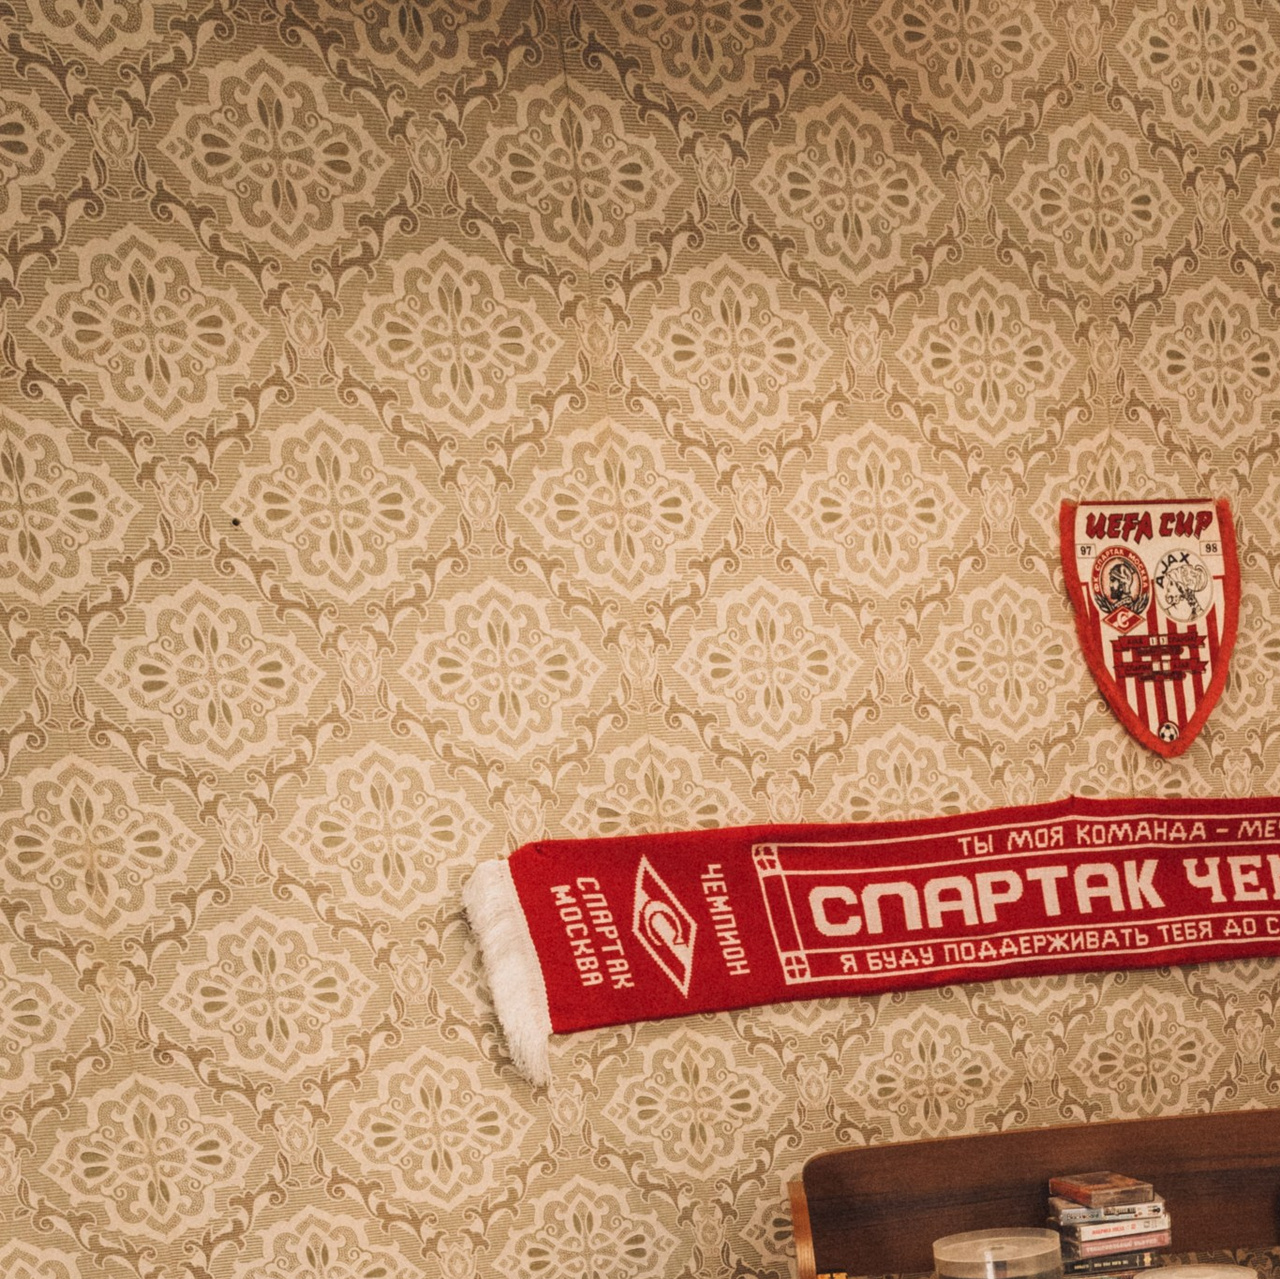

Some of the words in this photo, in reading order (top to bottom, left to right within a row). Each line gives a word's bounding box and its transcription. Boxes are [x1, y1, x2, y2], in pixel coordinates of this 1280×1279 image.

[1086, 511, 1153, 544] UEFA
[1159, 510, 1213, 540] CUP
[1080, 546, 1092, 555] 97
[1096, 548, 1125, 571] СПАРТАК
[1128, 553, 1148, 588] МОСКВА
[1205, 543, 1218, 553] 98
[1156, 552, 1190, 589] AJAX
[958, 834, 993, 856] ТЫ
[1007, 826, 1064, 850] МОЯ
[1077, 819, 1206, 845] КОМАНДА
[808, 860, 1166, 936] СПАРТАК
[550, 885, 604, 986] МОСКВА
[576, 877, 635, 989] СПАРТАК
[700, 864, 750, 975] ЧЕМПИОН
[840, 953, 858, 973] Я
[866, 946, 934, 971] БУДУ
[944, 928, 1149, 963] ПОДДЕРЖИВАТЬ
[1158, 923, 1213, 943] ТЕБЯ
[1223, 918, 1257, 937] ДО
